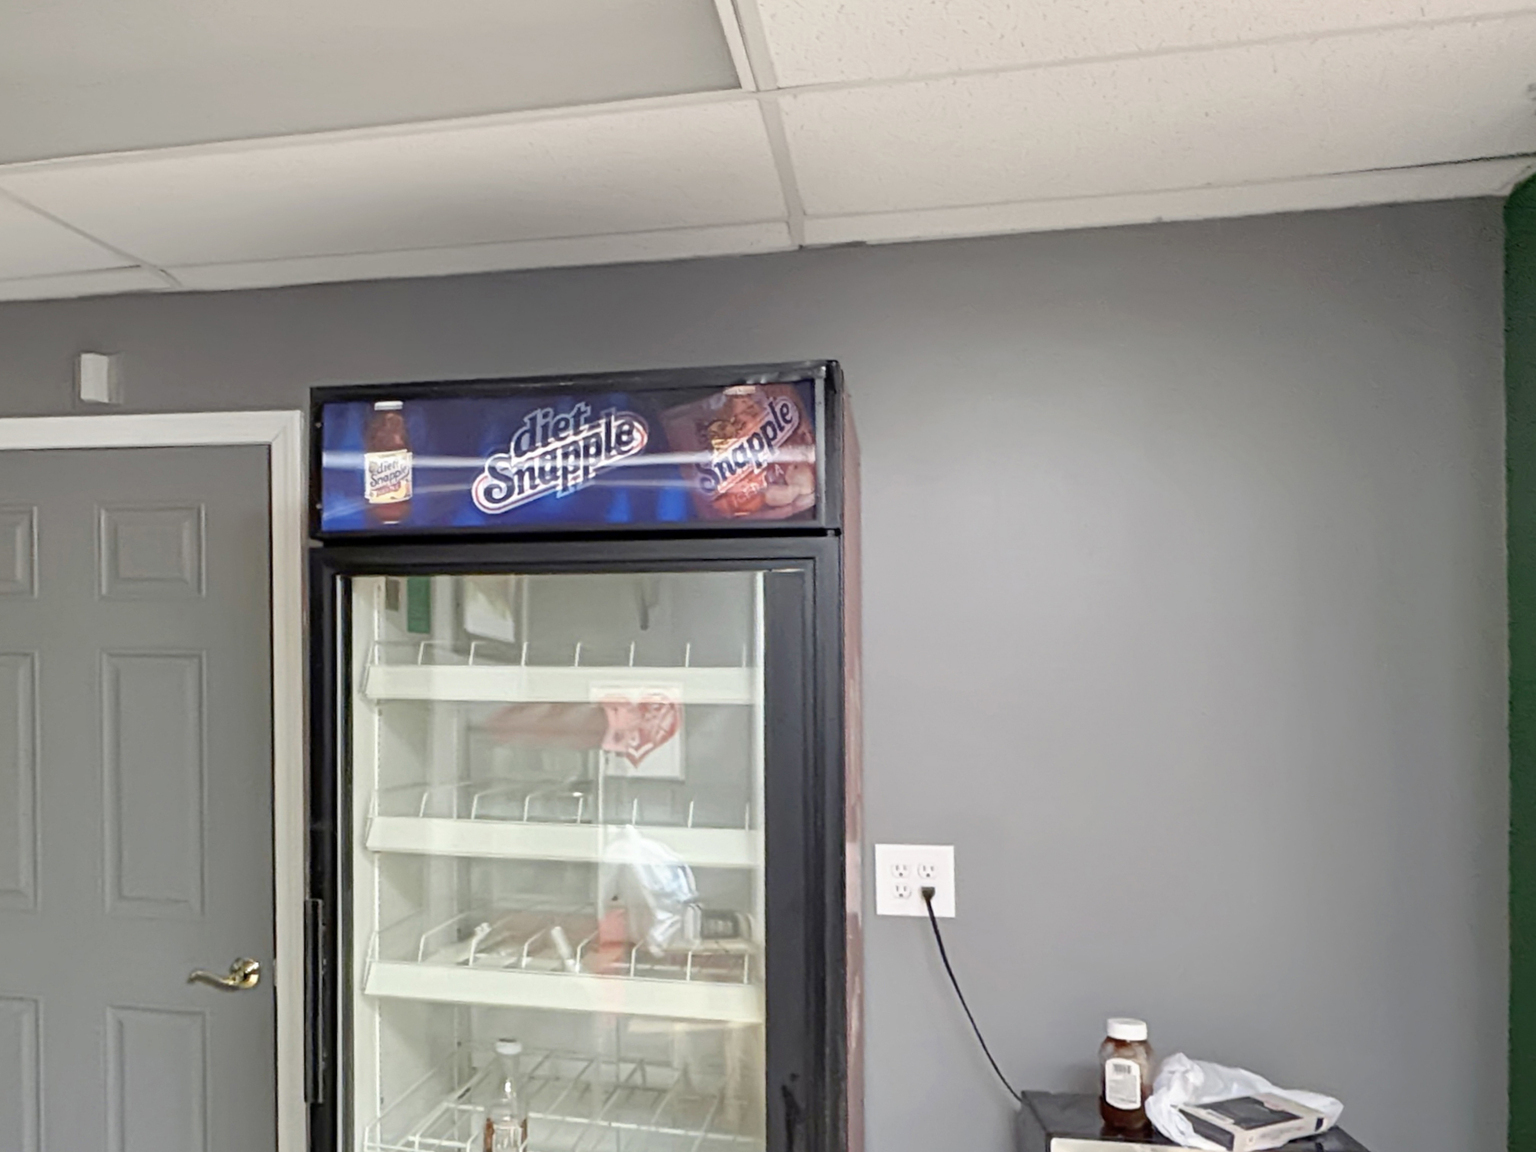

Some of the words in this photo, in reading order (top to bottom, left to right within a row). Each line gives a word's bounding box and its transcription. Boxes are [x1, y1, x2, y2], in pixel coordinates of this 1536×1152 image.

[479, 409, 640, 505] Snapple
[513, 402, 591, 459] diet
[694, 400, 795, 495] Snapple
[369, 465, 409, 488] Snapple
